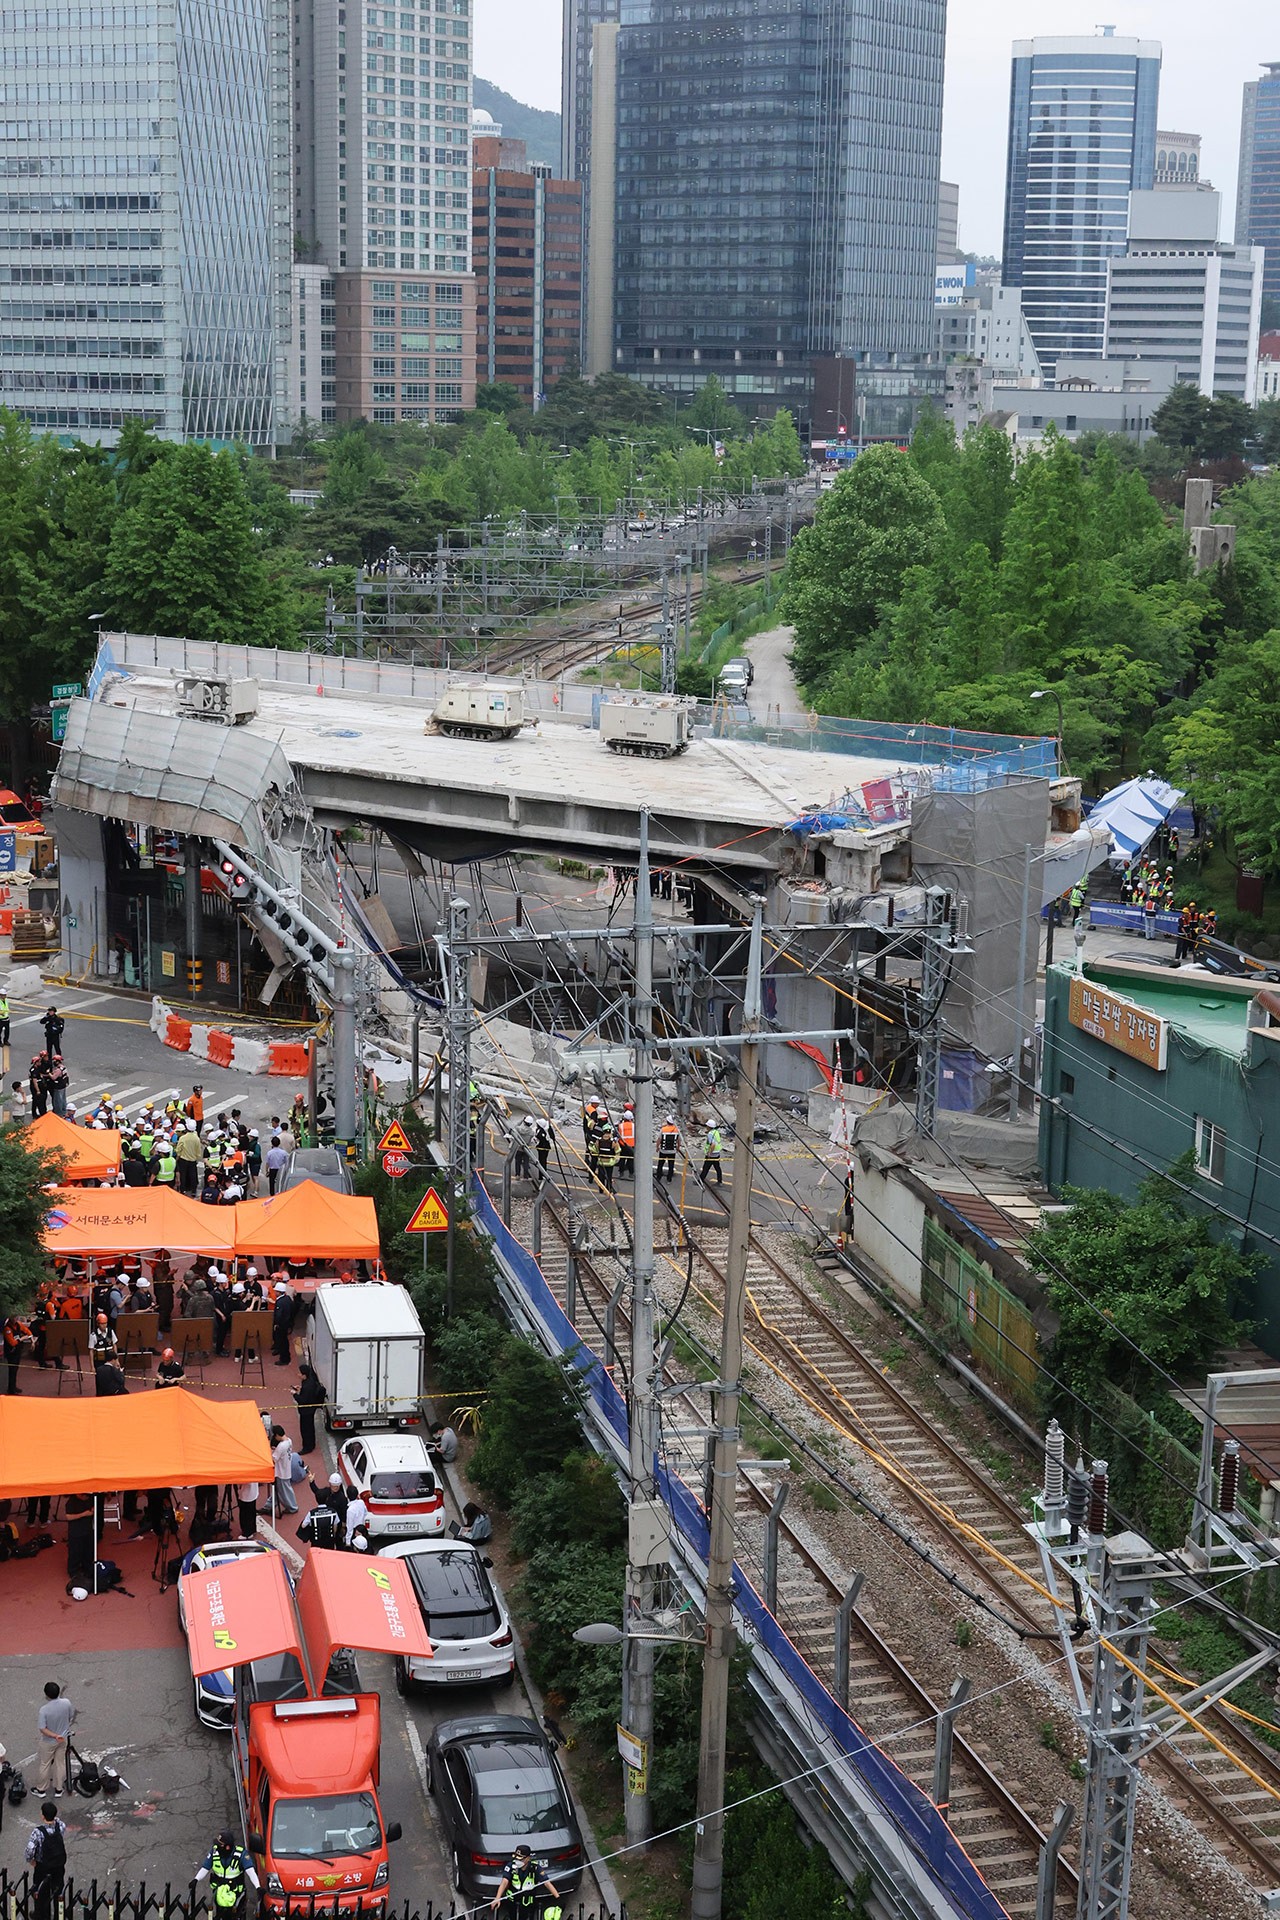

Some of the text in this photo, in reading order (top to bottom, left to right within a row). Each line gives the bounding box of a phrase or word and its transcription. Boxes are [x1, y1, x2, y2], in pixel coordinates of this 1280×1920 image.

[936, 277, 963, 288] EWON
[76, 1213, 147, 1226] 서대문소방서
[422, 1210, 440, 1220] 위험
[206, 1580, 238, 1650] 긴급구조통제단 119
[296, 1872, 362, 1887] 서울 소방
